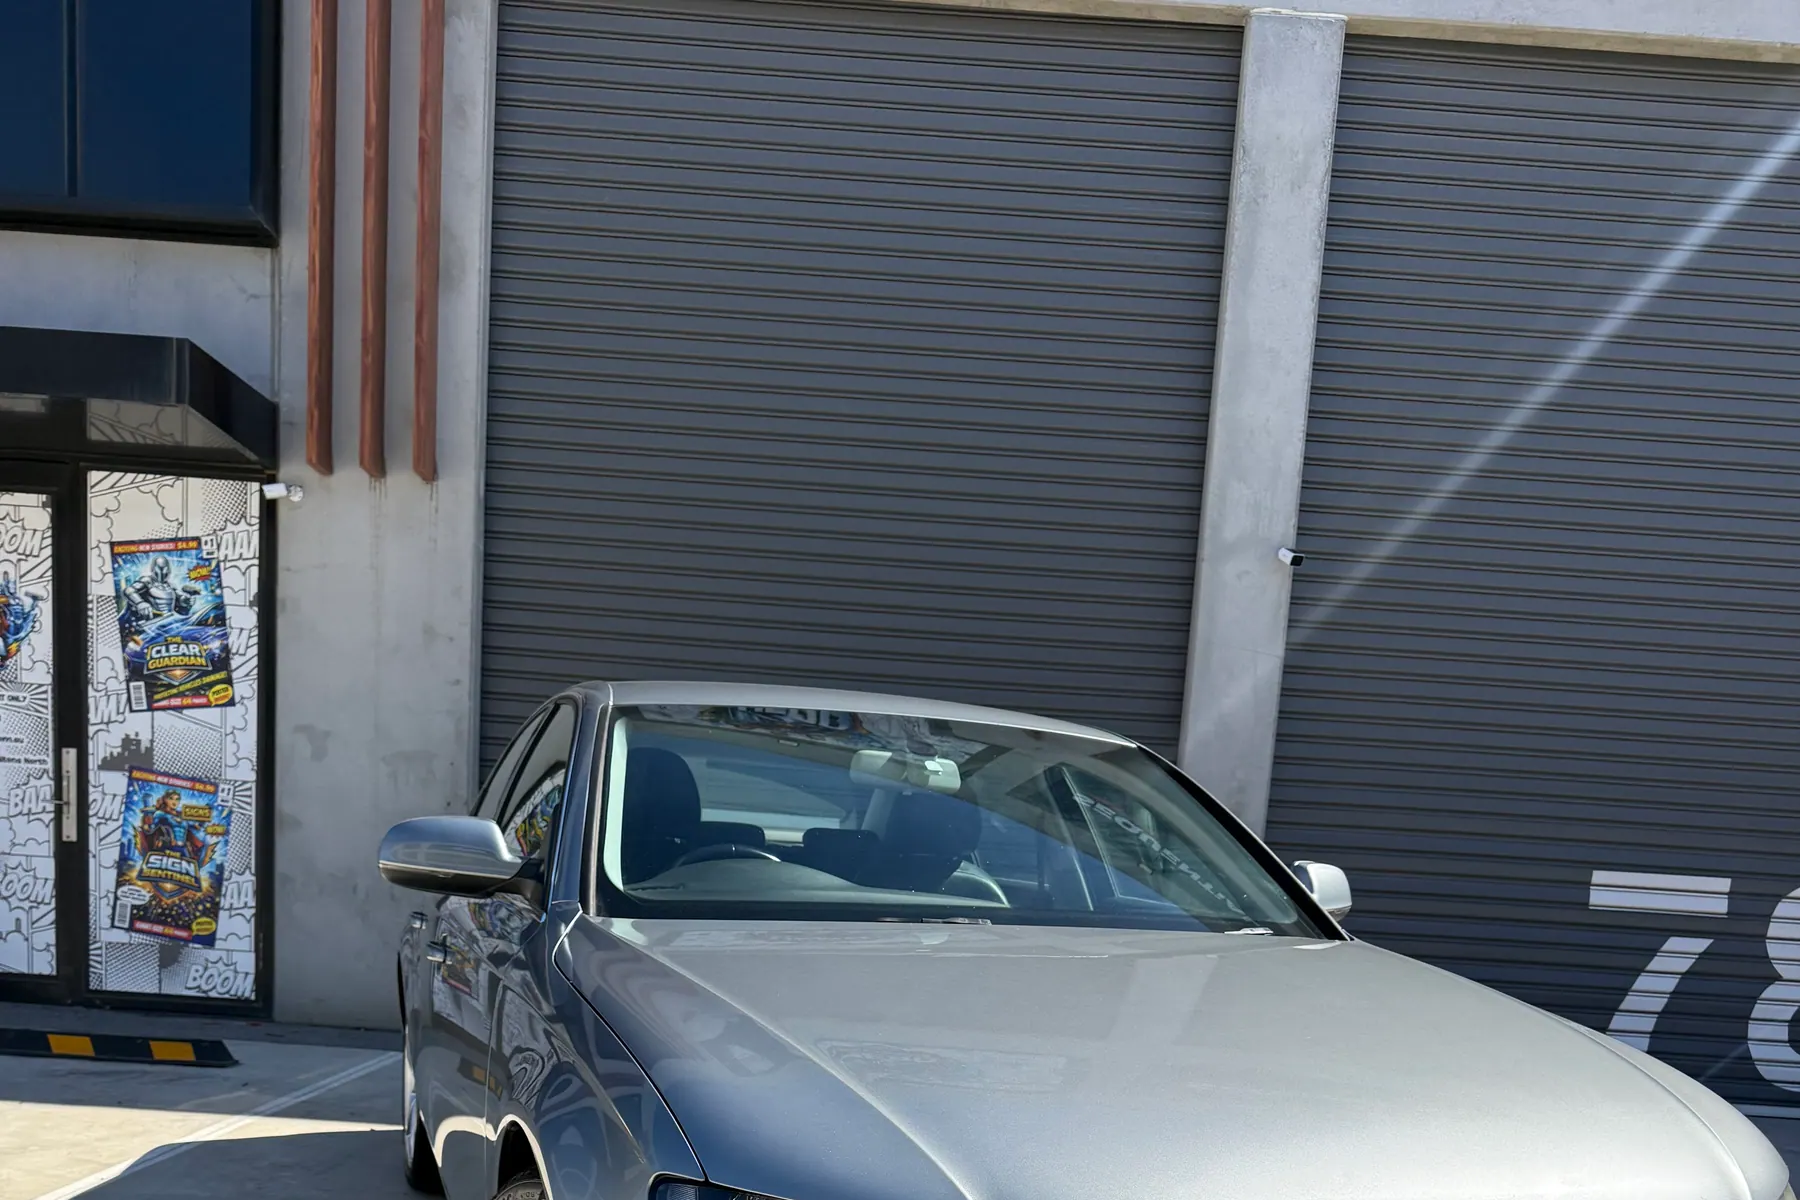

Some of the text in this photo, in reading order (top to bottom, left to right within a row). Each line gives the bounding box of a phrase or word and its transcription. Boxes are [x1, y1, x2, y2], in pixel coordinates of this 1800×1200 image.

[151, 643, 201, 658] CLEAR
[147, 656, 207, 669] GUARDIAN
[165, 849, 181, 858] THE
[146, 855, 196, 877] SIGN
[141, 868, 199, 887] SENTINEL
[185, 964, 256, 999] BOOM
